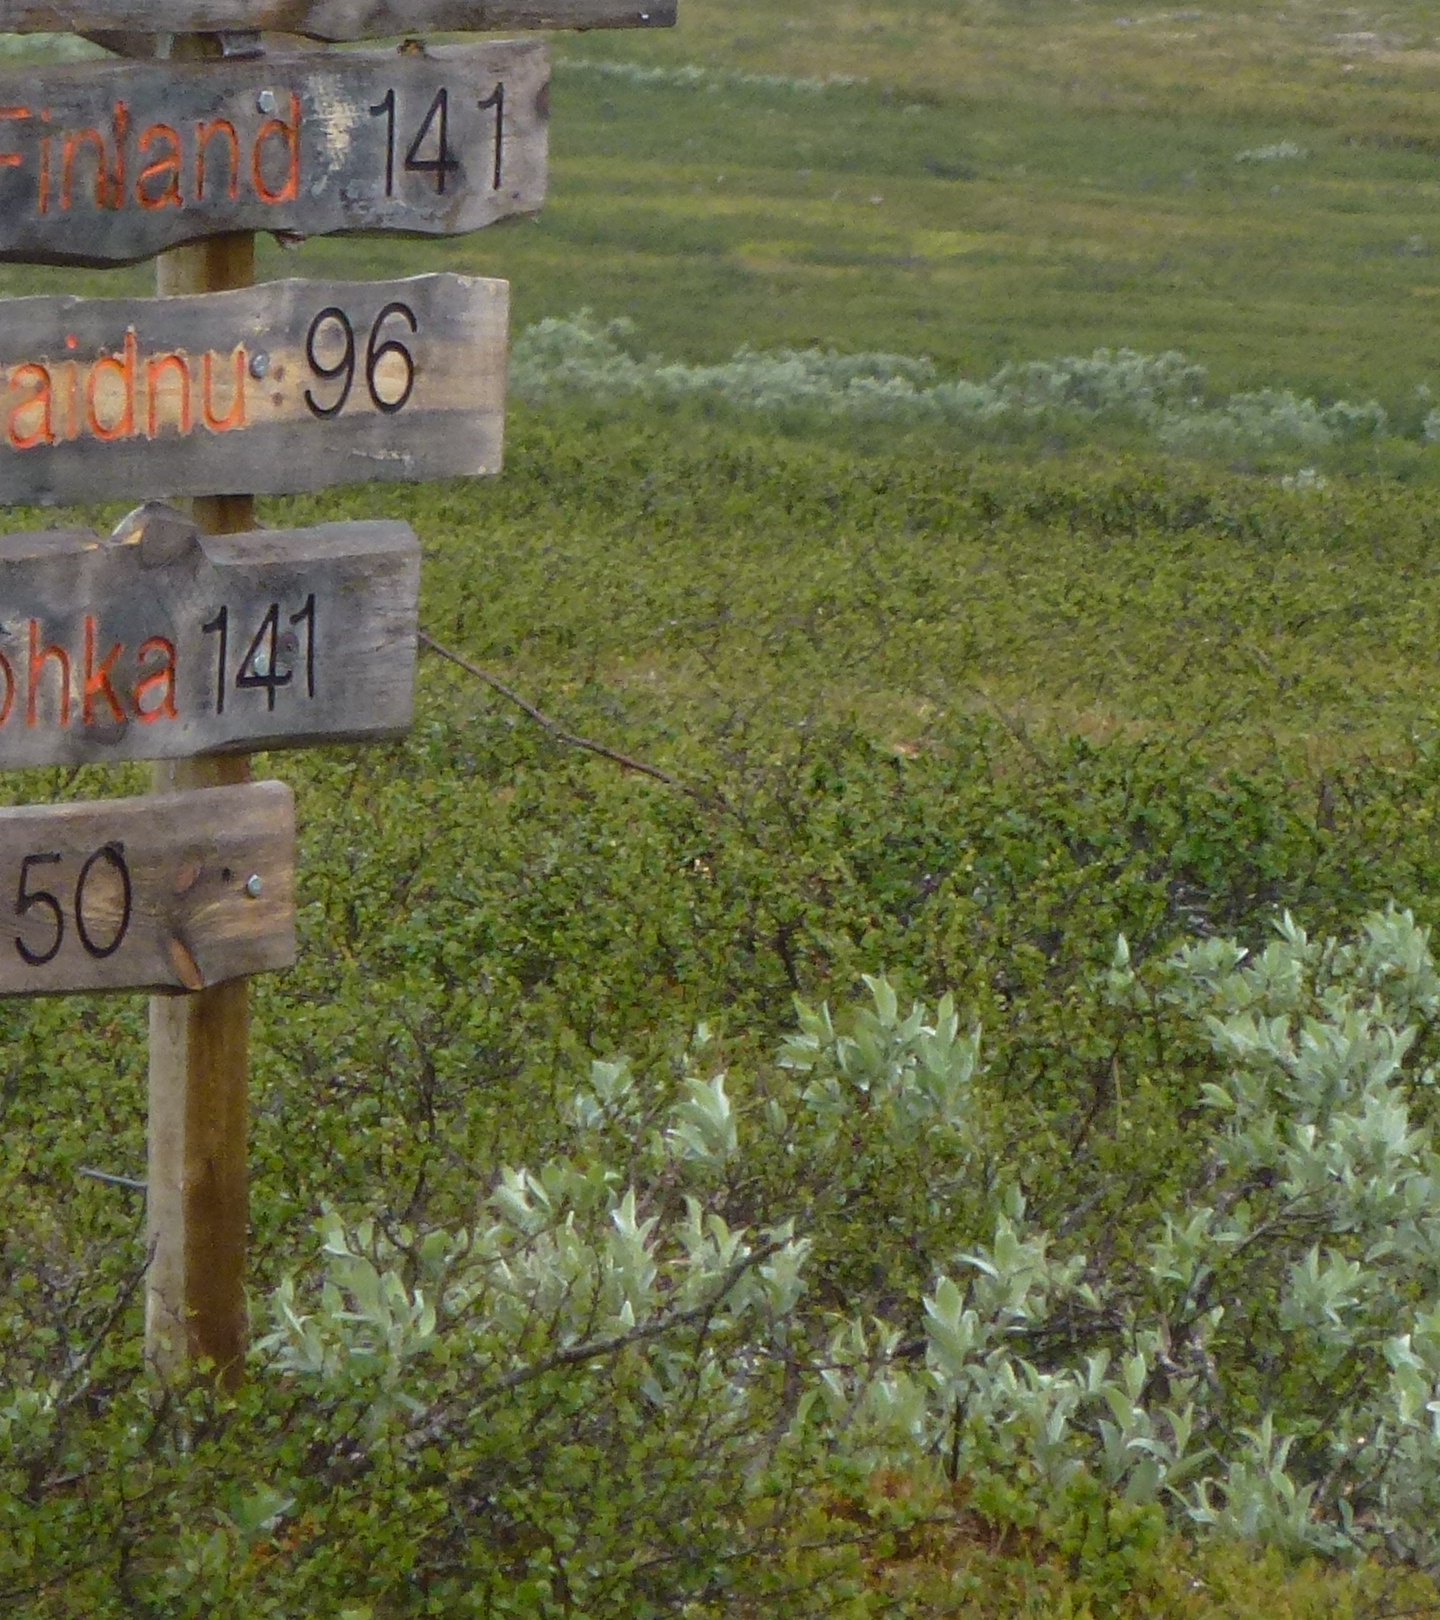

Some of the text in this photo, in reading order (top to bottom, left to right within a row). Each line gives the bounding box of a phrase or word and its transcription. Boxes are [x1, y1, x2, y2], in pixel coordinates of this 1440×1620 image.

[369, 82, 504, 198] 141
[304, 301, 418, 421] 96
[201, 592, 316, 715] 141
[14, 840, 132, 966] 50
